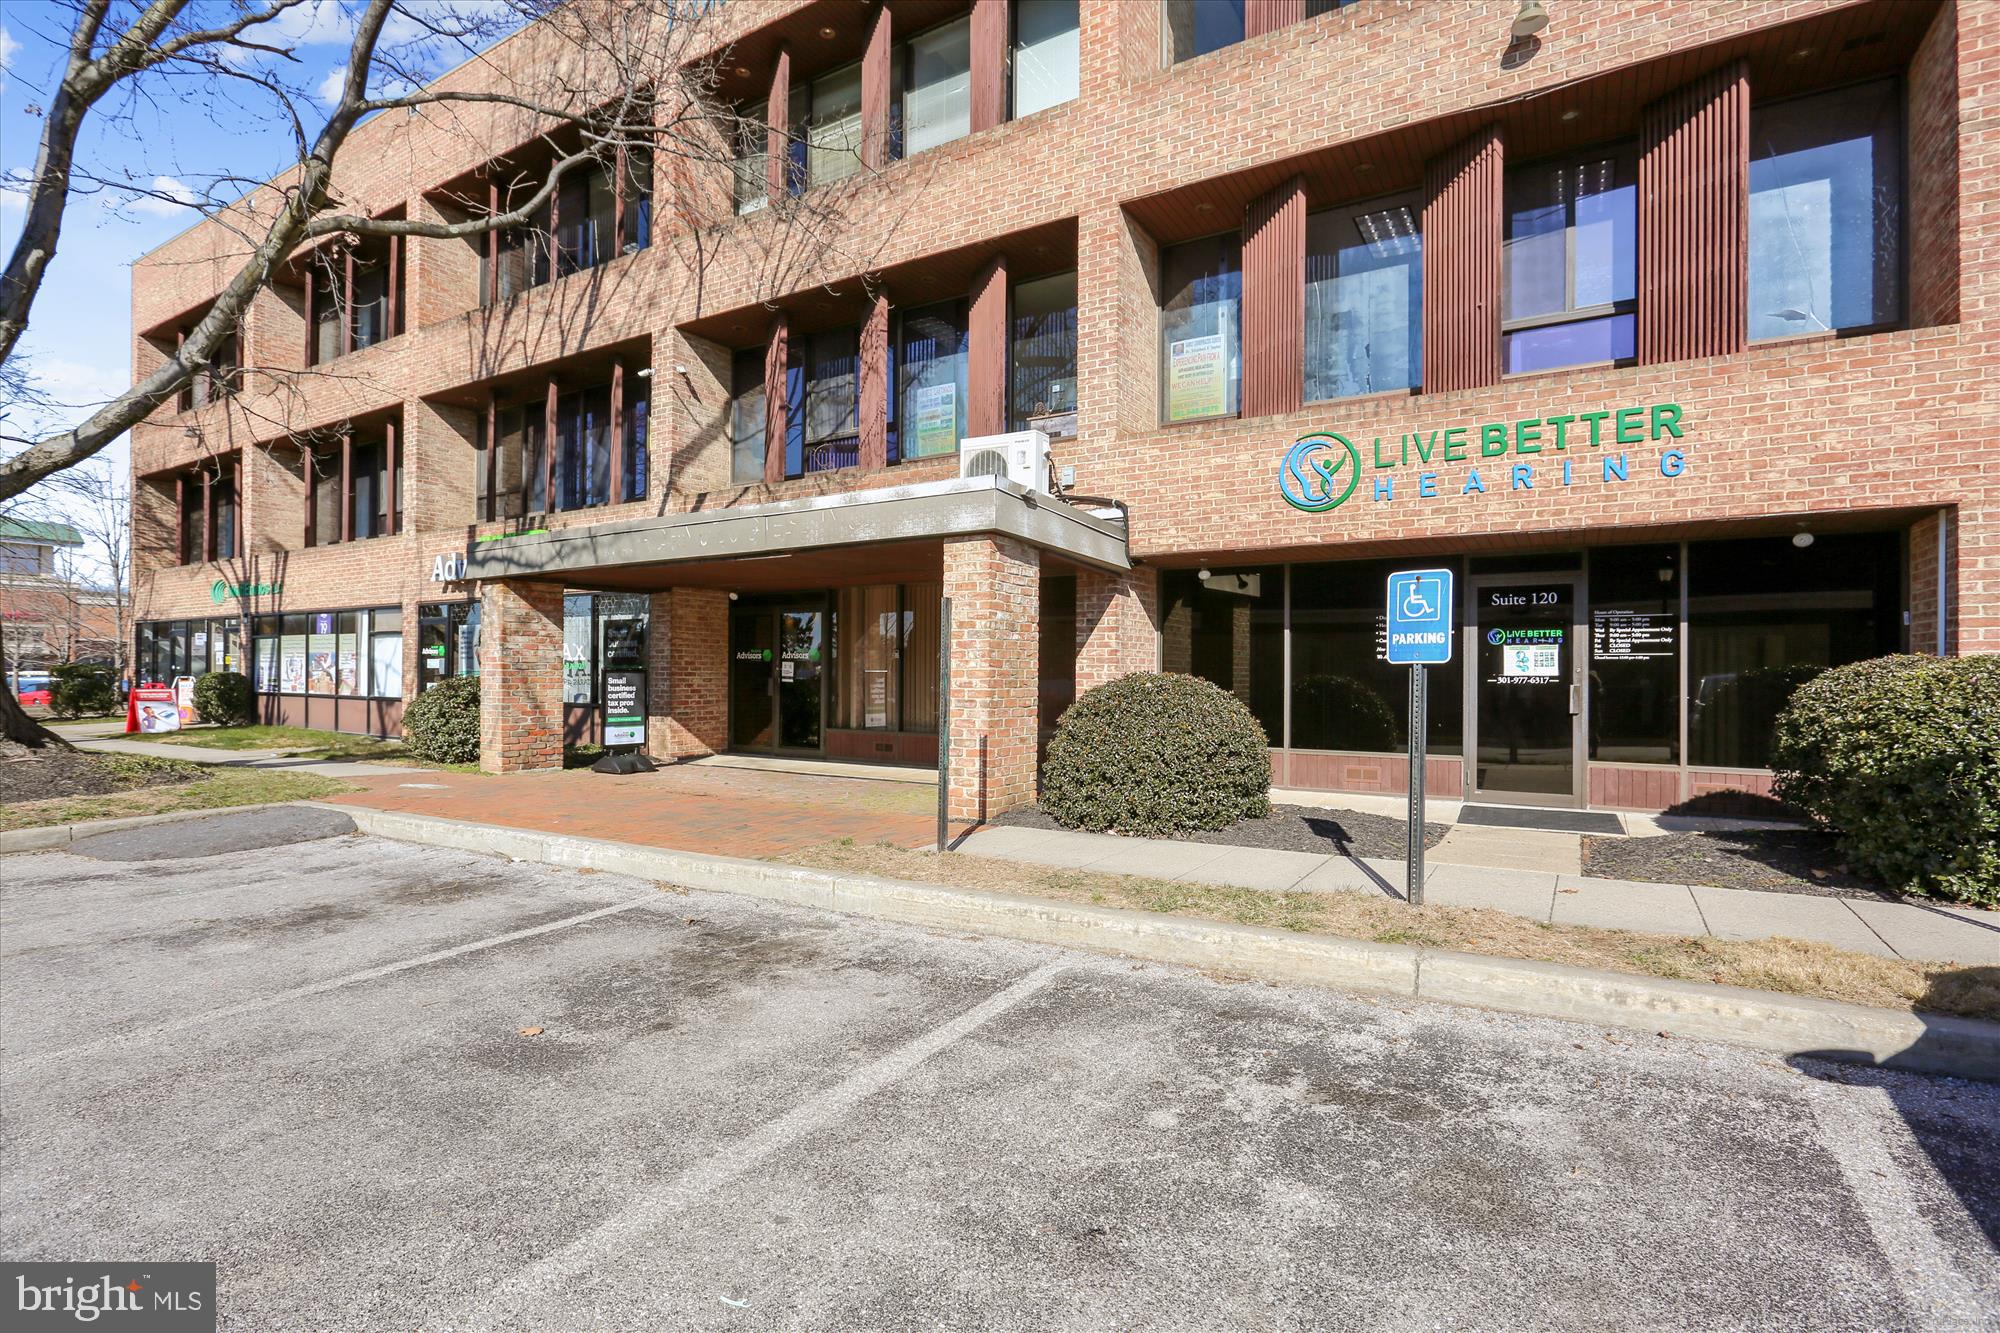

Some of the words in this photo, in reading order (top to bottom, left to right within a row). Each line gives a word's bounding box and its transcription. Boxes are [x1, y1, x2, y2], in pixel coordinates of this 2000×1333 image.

[1374, 427, 1467, 469] LIVE
[1481, 403, 1685, 458] BETTER
[1374, 449, 1686, 502] HEARING
[1491, 593, 1526, 606] Suite
[1532, 592, 1558, 605] 120
[1507, 630, 1526, 638] LIVE
[1392, 632, 1446, 645] PARKING
[736, 652, 762, 660] Advisors
[782, 651, 809, 659] Advisors
[607, 677, 627, 685] Small
[607, 684, 636, 692] business
[619, 700, 634, 708] pros
[607, 706, 630, 714] inside.
